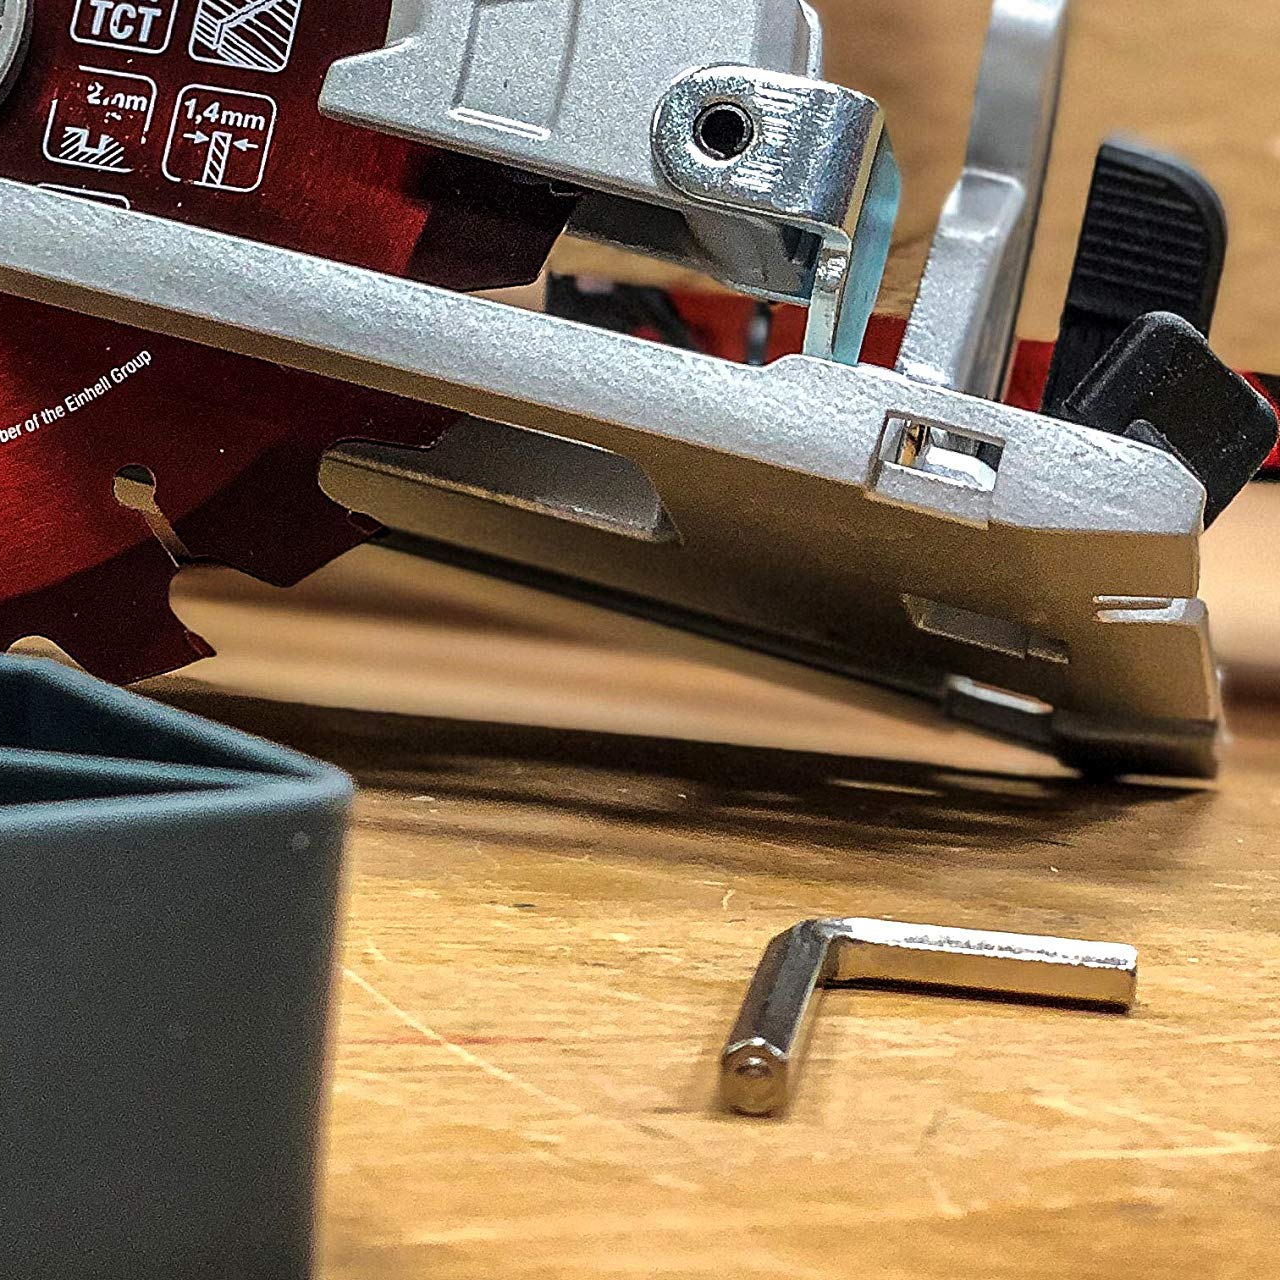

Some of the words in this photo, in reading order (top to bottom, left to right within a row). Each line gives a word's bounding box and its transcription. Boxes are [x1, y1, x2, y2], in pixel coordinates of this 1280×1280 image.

[90, 0, 162, 42] TCT
[23, 414, 41, 433] of
[39, 404, 67, 425] the
[62, 375, 114, 413] Einhell
[110, 348, 153, 385] Group
